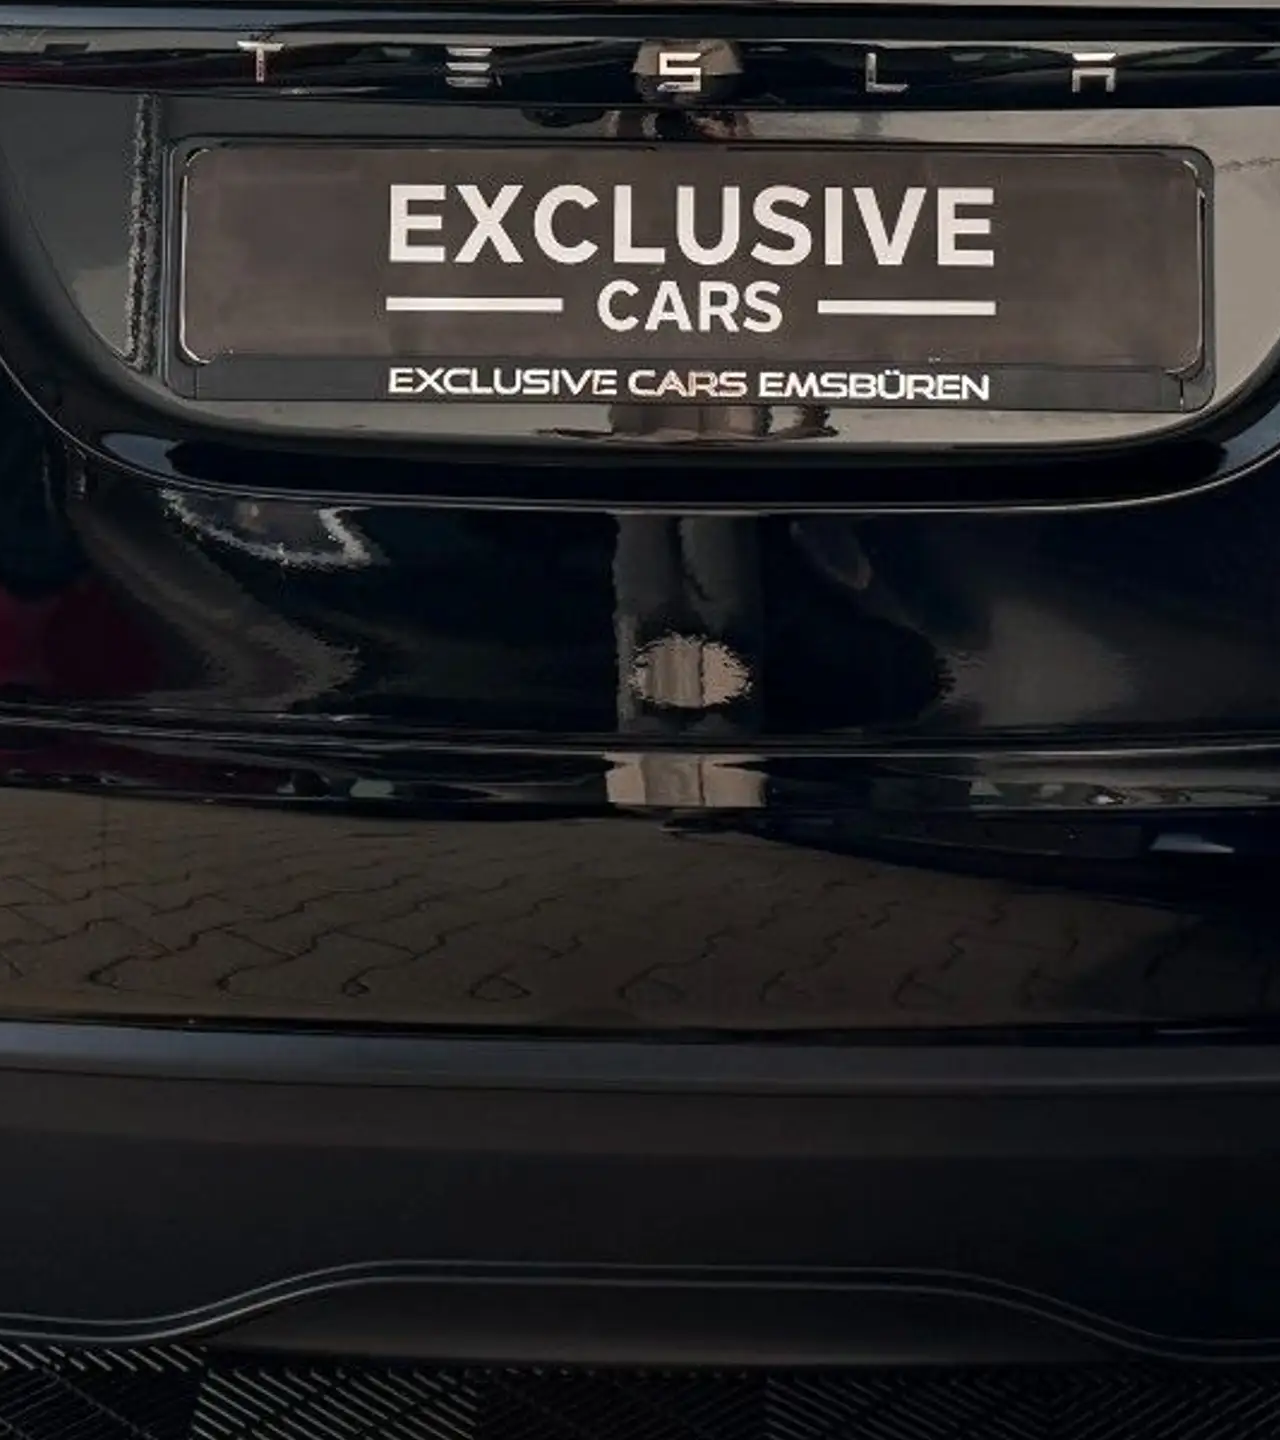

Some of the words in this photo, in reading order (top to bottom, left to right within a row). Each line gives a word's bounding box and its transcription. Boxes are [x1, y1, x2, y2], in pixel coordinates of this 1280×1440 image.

[236, 40, 1117, 94] TESLA
[388, 183, 995, 266] EXCLUSIVE
[596, 280, 784, 333] CARS
[387, 366, 618, 397] EXCLUSIVE
[628, 368, 748, 398] CARS
[759, 368, 990, 401] EMSBÜREN
